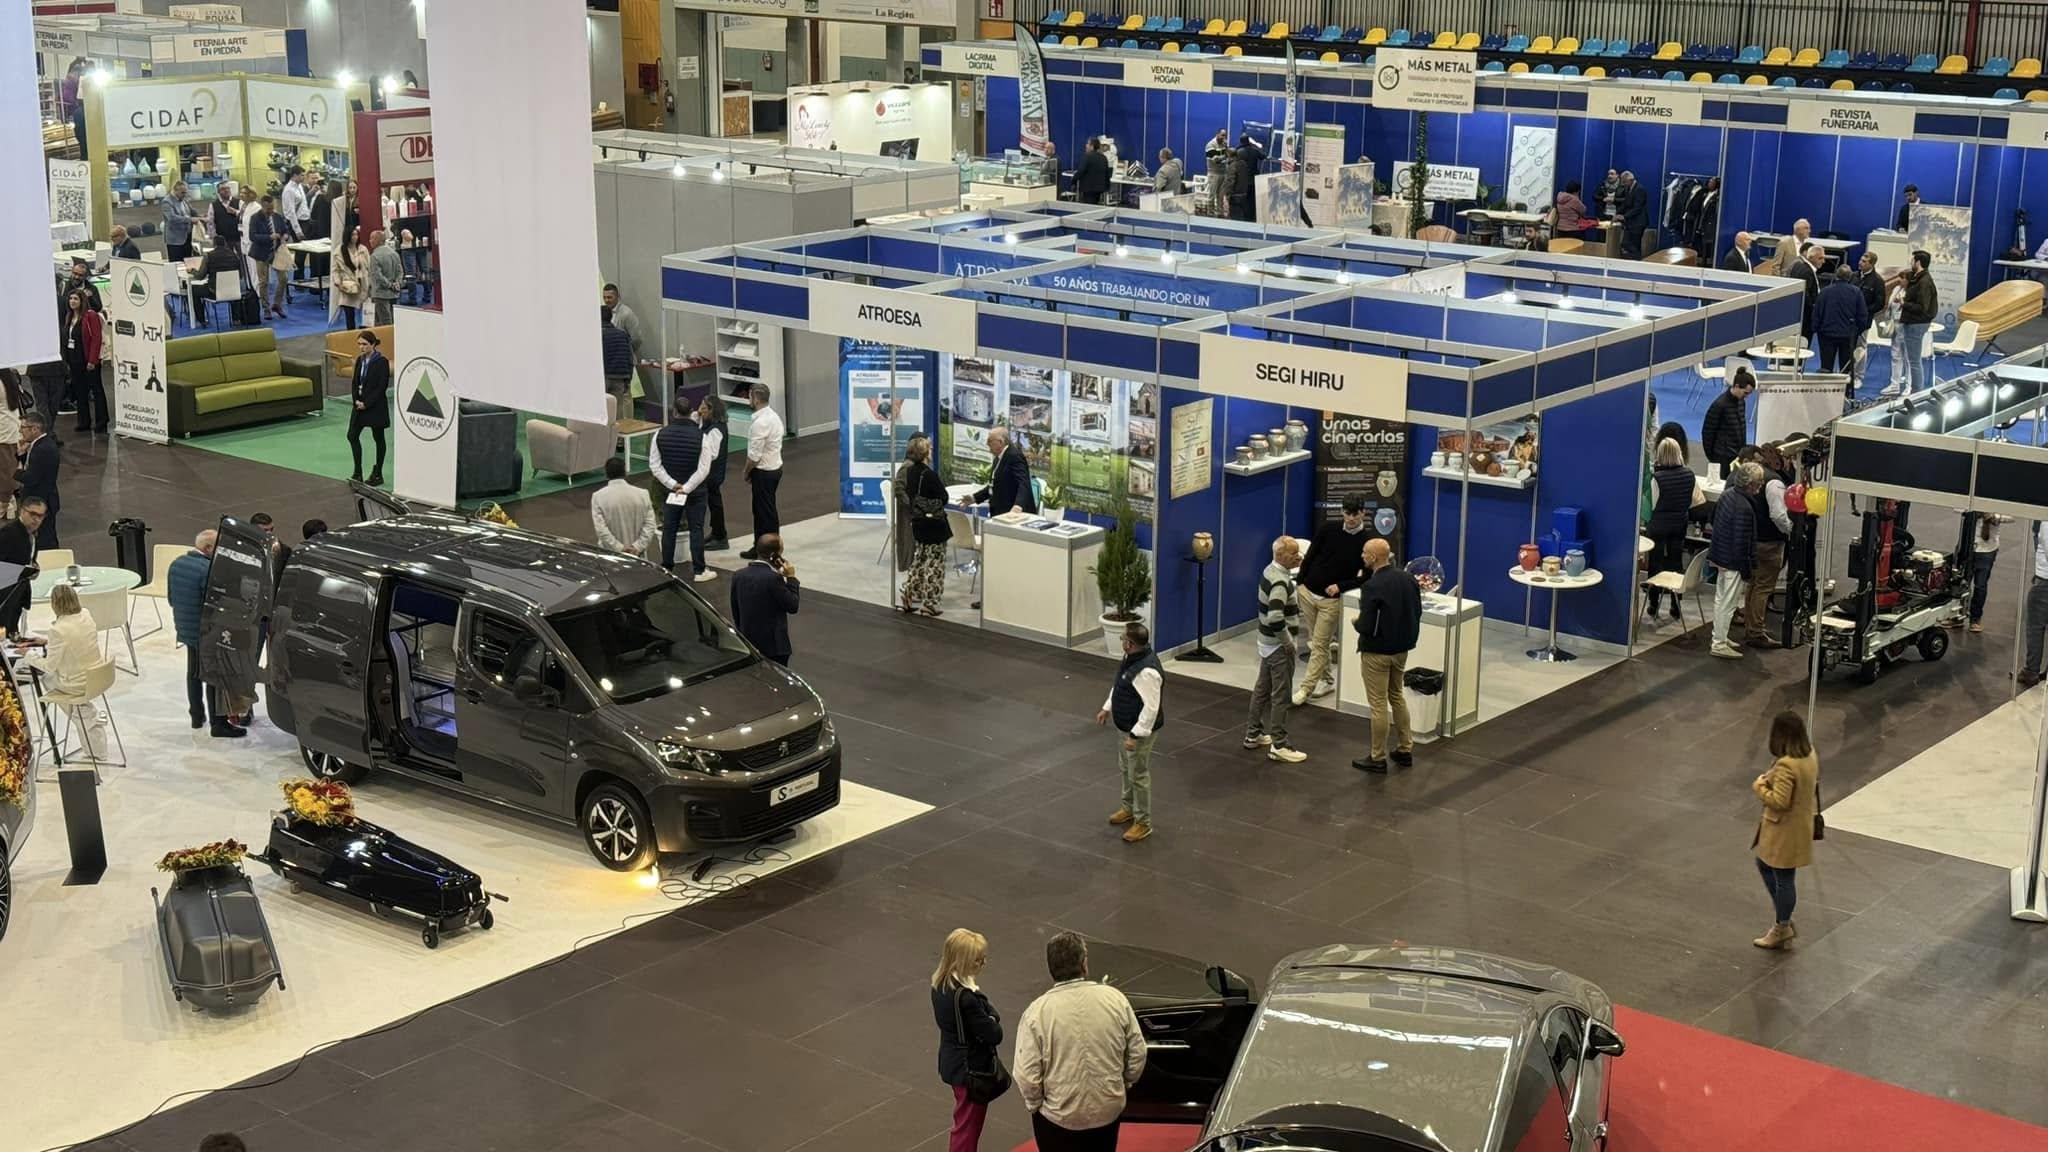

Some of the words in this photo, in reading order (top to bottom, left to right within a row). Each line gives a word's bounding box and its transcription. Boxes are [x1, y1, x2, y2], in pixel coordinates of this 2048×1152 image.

[193, 38, 226, 48] ETERNIA
[228, 37, 248, 45] ARTE
[201, 48, 212, 56] EN
[213, 46, 242, 55] PIEDRA
[968, 61, 995, 71] DIGITAL
[1151, 66, 1184, 76] VENTANA
[1407, 56, 1432, 72] MÁS
[1434, 61, 1473, 74] METAL
[1154, 75, 1181, 84] HOGAR
[1630, 96, 1656, 106] MUZI
[1614, 105, 1673, 117] UNIFORMES
[1830, 108, 1872, 120] REVISTA
[130, 107, 204, 130] CIDAF
[265, 106, 319, 130] CIDAF
[1820, 118, 1880, 131] FUNERARIA
[51, 168, 83, 178] CIDAF
[1444, 170, 1475, 181] METAL
[1053, 276, 1067, 288] 50
[1068, 277, 1099, 292] AÑOS
[1100, 281, 1169, 301] TRABAJANDO
[1169, 291, 1192, 304] POR
[1193, 295, 1210, 307] UN
[858, 304, 922, 328] ATROESA
[1256, 363, 1296, 385] SEGI
[1300, 369, 1344, 391] HIRU
[124, 413, 159, 425] ACCESORIOS
[1322, 430, 1405, 444] cinerarias
